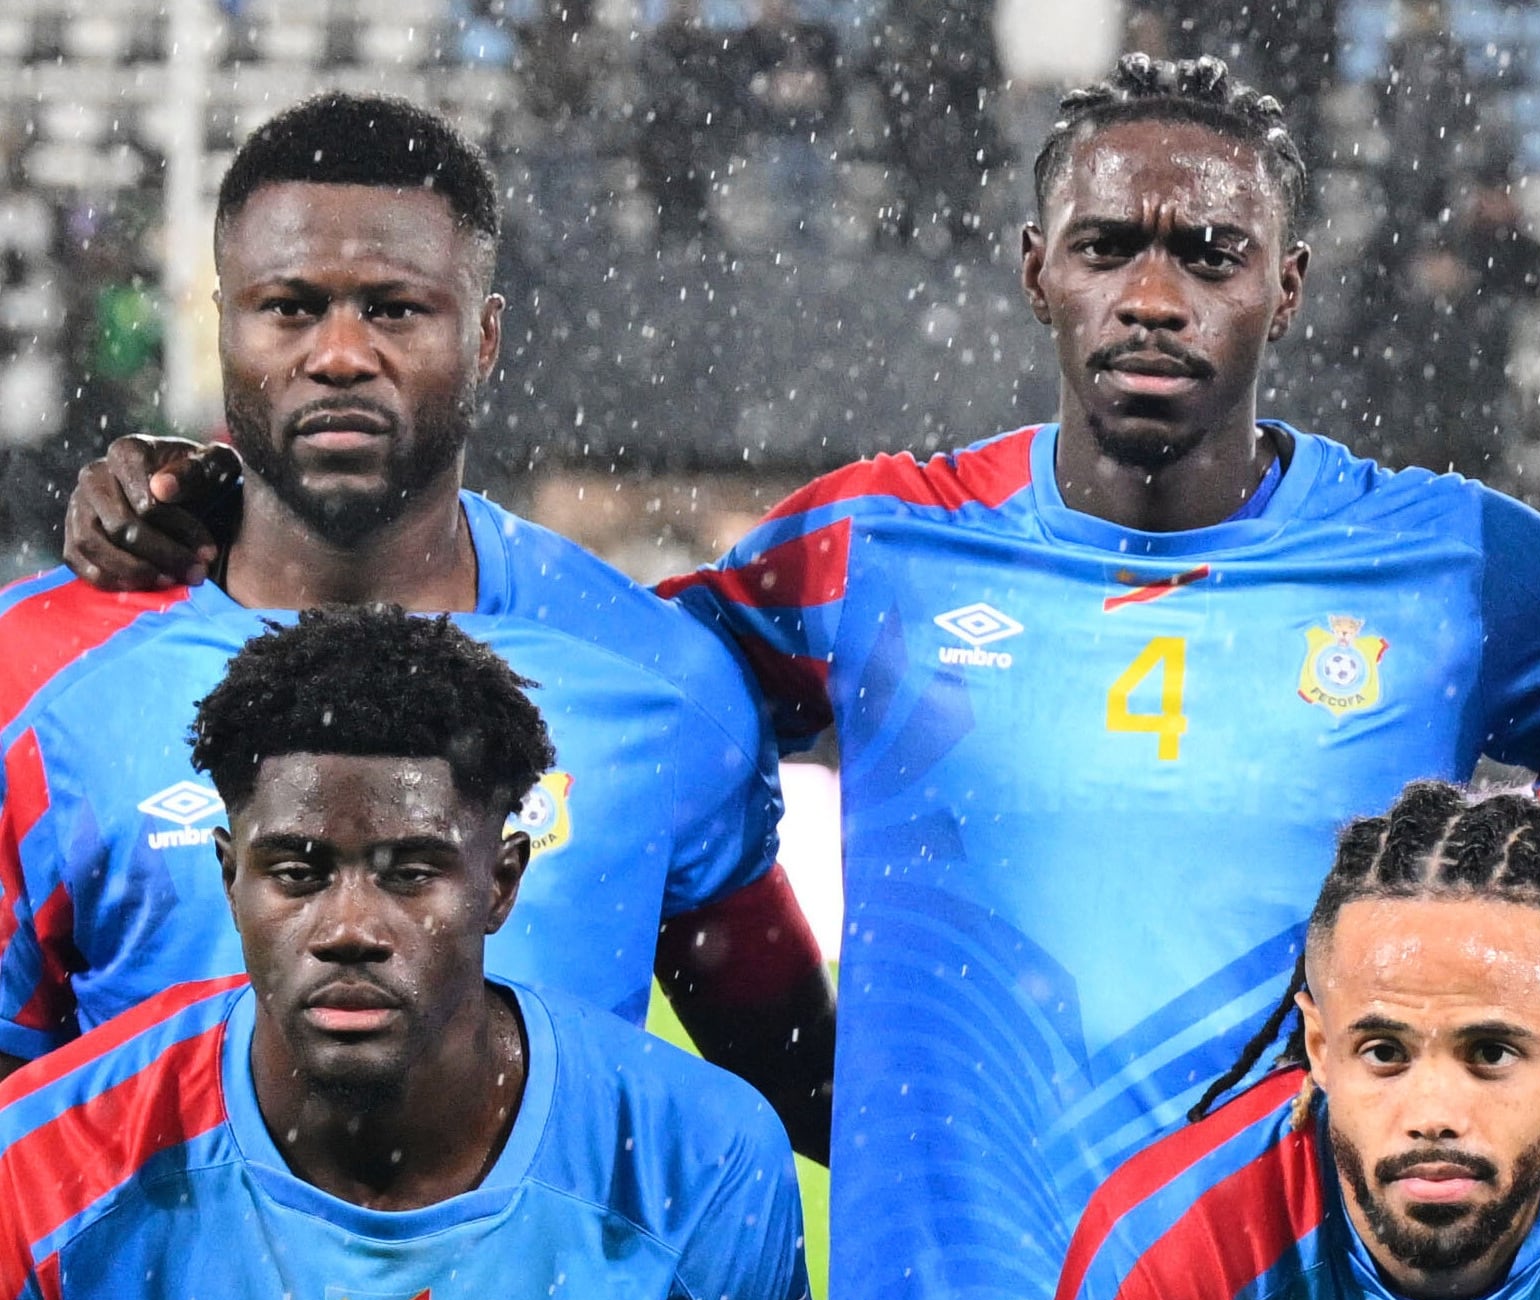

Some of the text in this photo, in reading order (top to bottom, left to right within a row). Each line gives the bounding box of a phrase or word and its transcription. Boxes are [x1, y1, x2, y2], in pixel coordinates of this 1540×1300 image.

[938, 645, 1012, 669] umbro
[1106, 636, 1188, 760] 4
[1310, 686, 1366, 707] FECOFA
[148, 825, 214, 850] umbr
[531, 833, 557, 849] OFA
